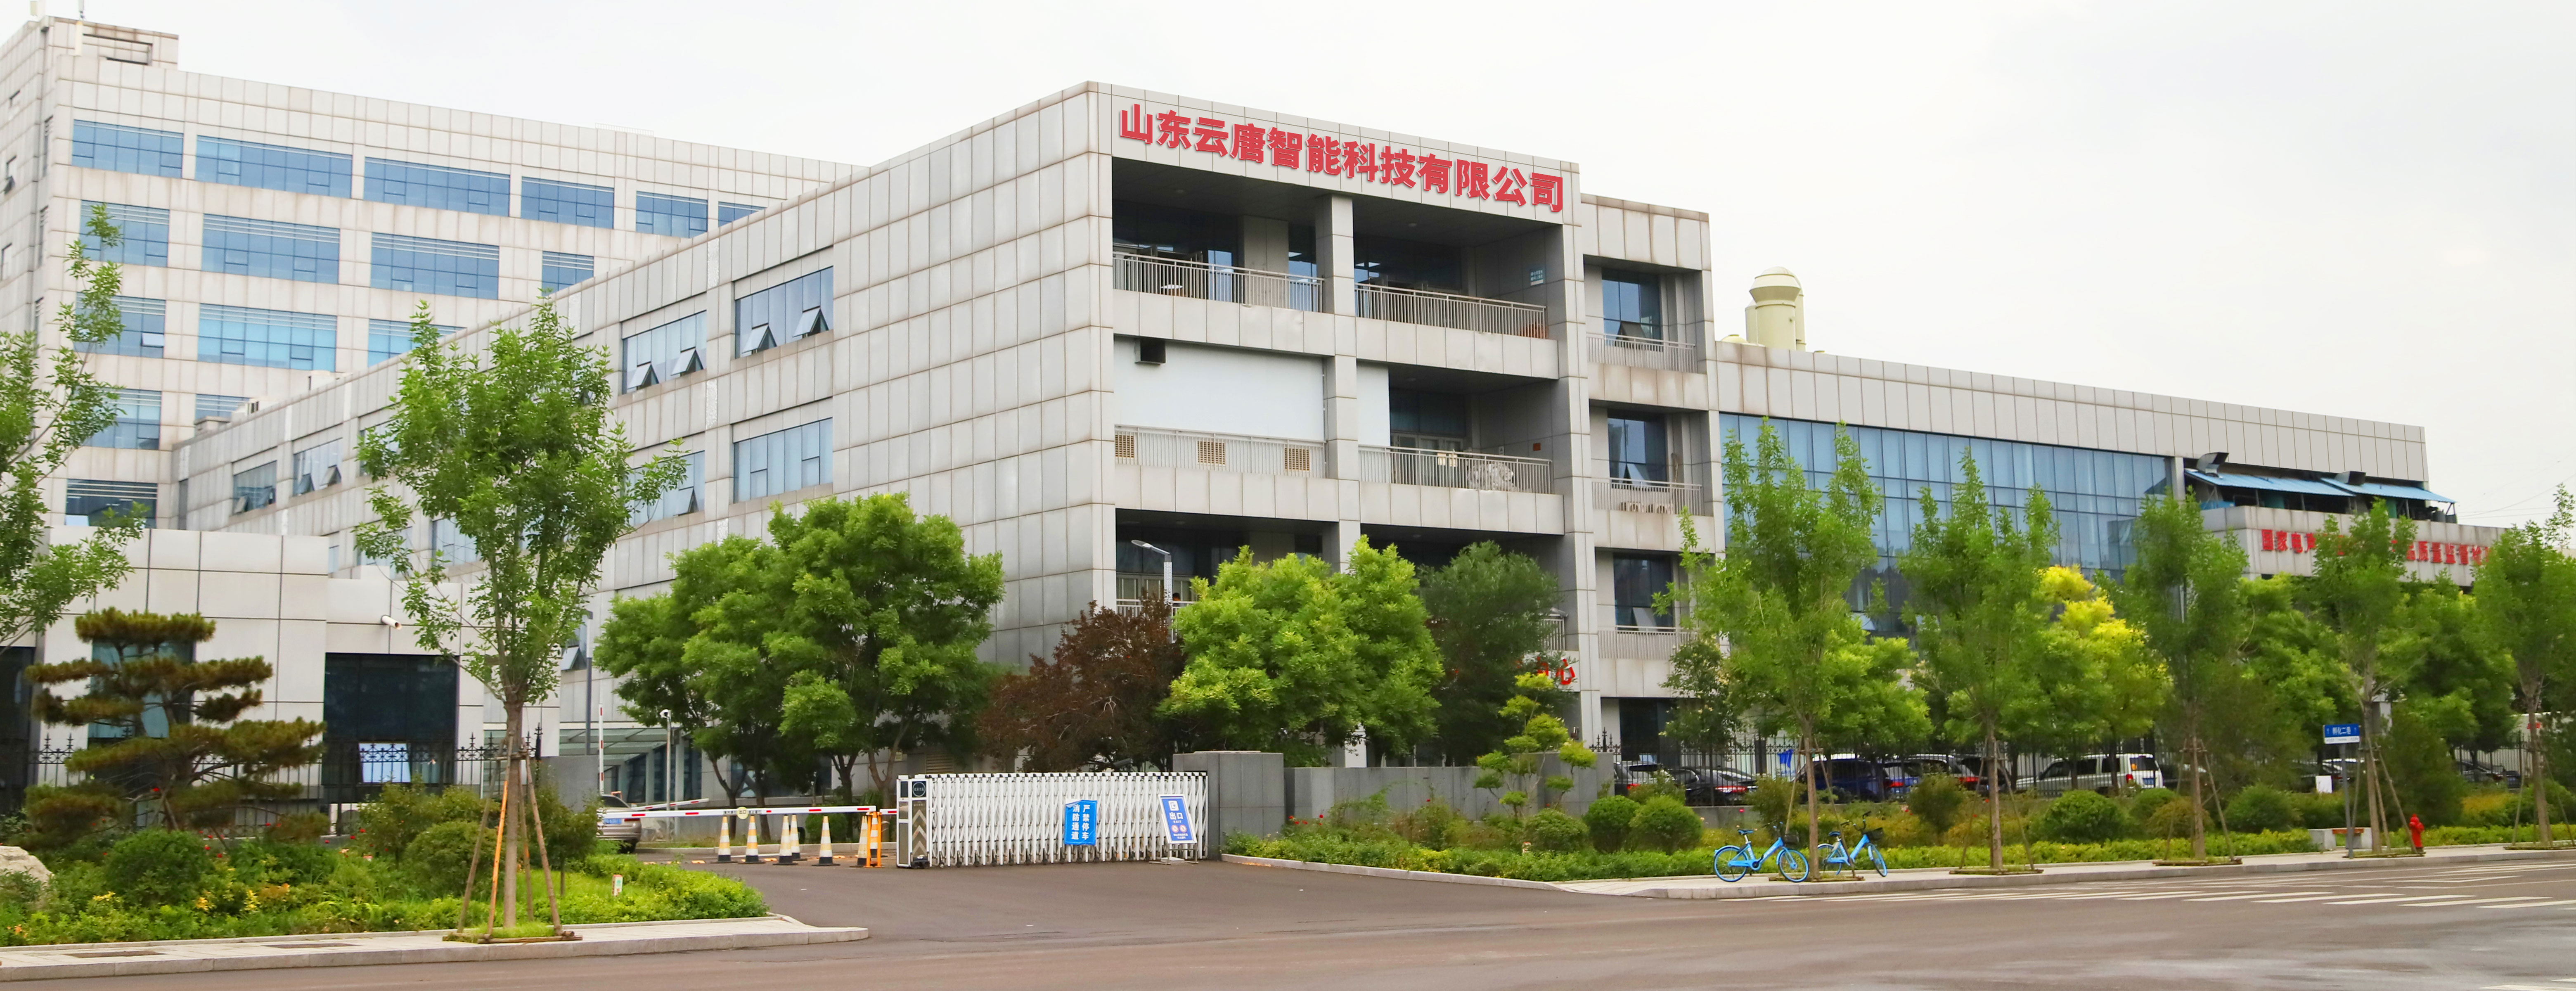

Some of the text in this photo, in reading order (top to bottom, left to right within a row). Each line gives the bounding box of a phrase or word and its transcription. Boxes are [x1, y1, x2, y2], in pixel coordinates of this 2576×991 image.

[1119, 104, 1563, 212] 山东云唐智能科技有限公司
[1071, 804, 1080, 840] 消防通道
[1082, 804, 1090, 840] 严禁停车
[1169, 812, 1184, 820] 出口
